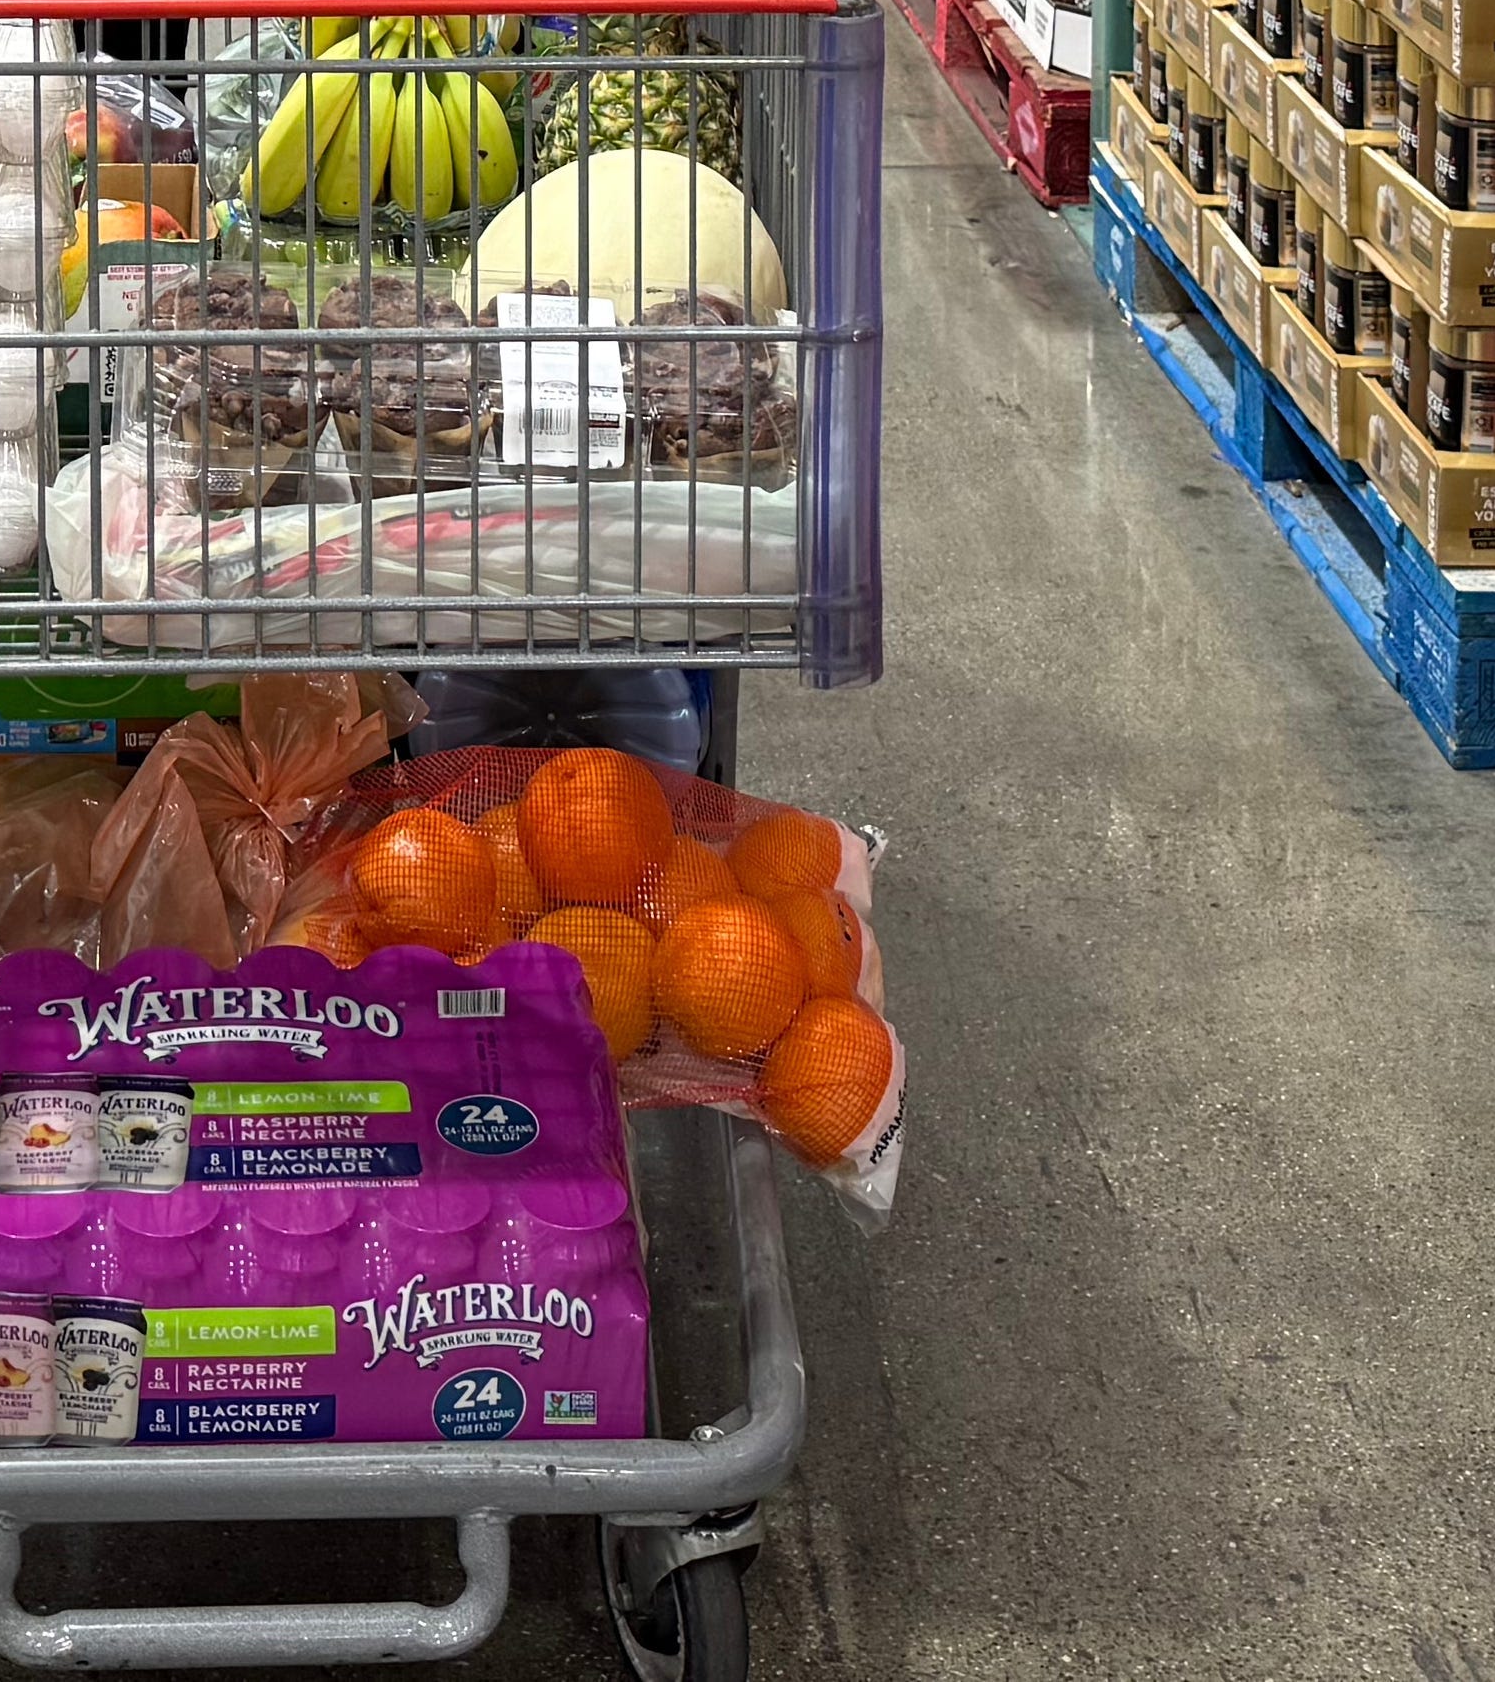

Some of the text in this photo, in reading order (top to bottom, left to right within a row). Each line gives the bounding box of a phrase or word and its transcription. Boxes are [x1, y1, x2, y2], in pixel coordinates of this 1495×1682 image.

[38, 976, 399, 1061] WATERLOO
[157, 1027, 312, 1044] SPARKLING WATER
[238, 1091, 381, 1105] LEMON-LIME
[241, 1115, 368, 1129] RASPBERRY
[460, 1104, 509, 1125] 24
[208, 1119, 217, 1132] 8
[241, 1127, 365, 1140] NECTARINE
[210, 1153, 220, 1167] 8
[242, 1147, 387, 1162] BLACKBERRY
[242, 1161, 372, 1175] LEMONADE
[343, 1274, 592, 1369] WATERLOO
[155, 1321, 164, 1336] 8
[188, 1324, 319, 1340] LEMON-LIME
[427, 1331, 535, 1352] SPARKLING WATER
[154, 1367, 163, 1381] 8
[188, 1361, 307, 1377] RASPBERRY
[187, 1376, 303, 1391] NECTARINE
[453, 1377, 501, 1409] 24
[155, 1409, 165, 1423] 8
[189, 1402, 320, 1418] BLACKBERRY
[187, 1418, 303, 1433] LEMONADE
